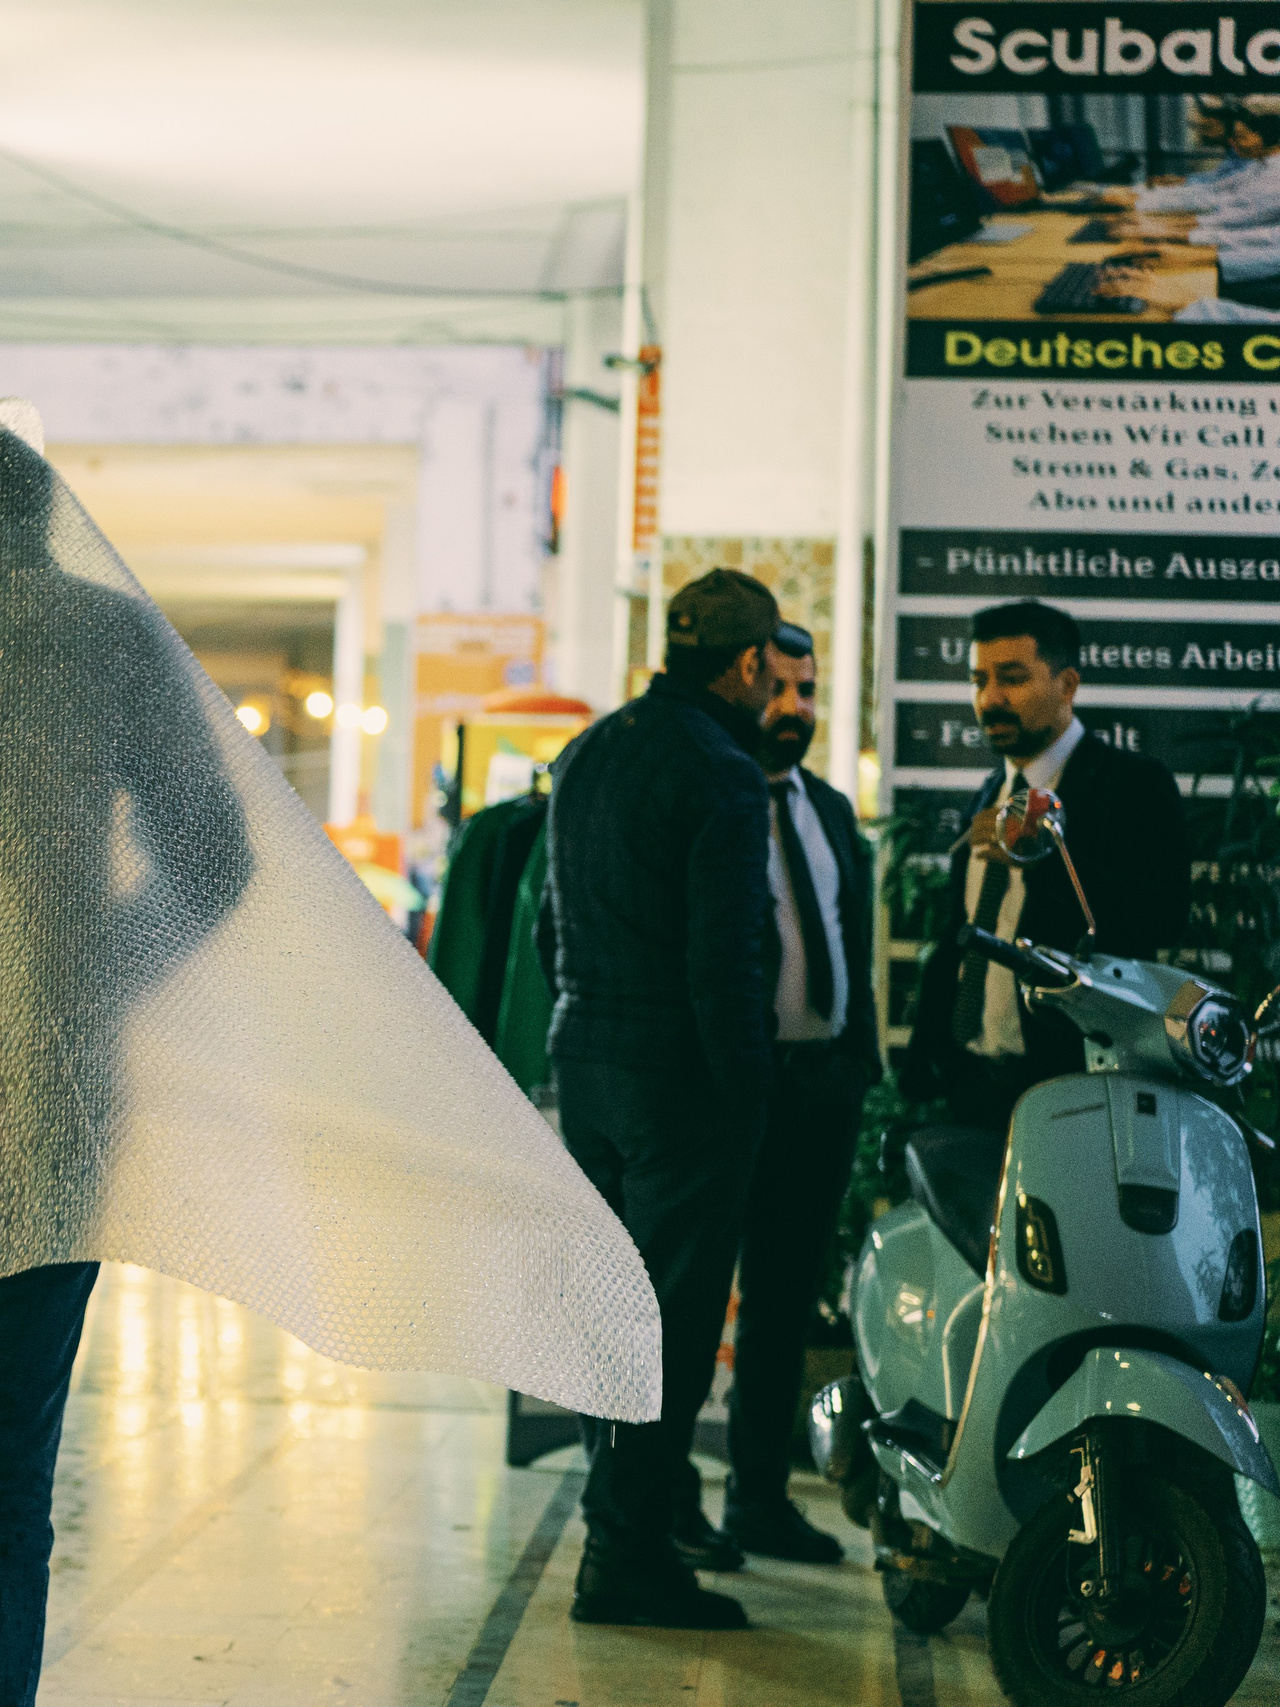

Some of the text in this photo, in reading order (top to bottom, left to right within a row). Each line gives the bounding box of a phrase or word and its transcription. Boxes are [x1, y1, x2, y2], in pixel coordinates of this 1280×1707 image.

[945, 330, 1224, 369] Deutsches
[972, 388, 1030, 410] Zur
[1041, 388, 1257, 418] Verstärkung
[985, 422, 1265, 447] Suchen Wir Call
[1012, 456, 1117, 478] Strom
[1128, 457, 1152, 478] &
[1029, 490, 1098, 511] Abo
[1107, 490, 1175, 513] und
[946, 547, 1155, 578] Pünktliche
